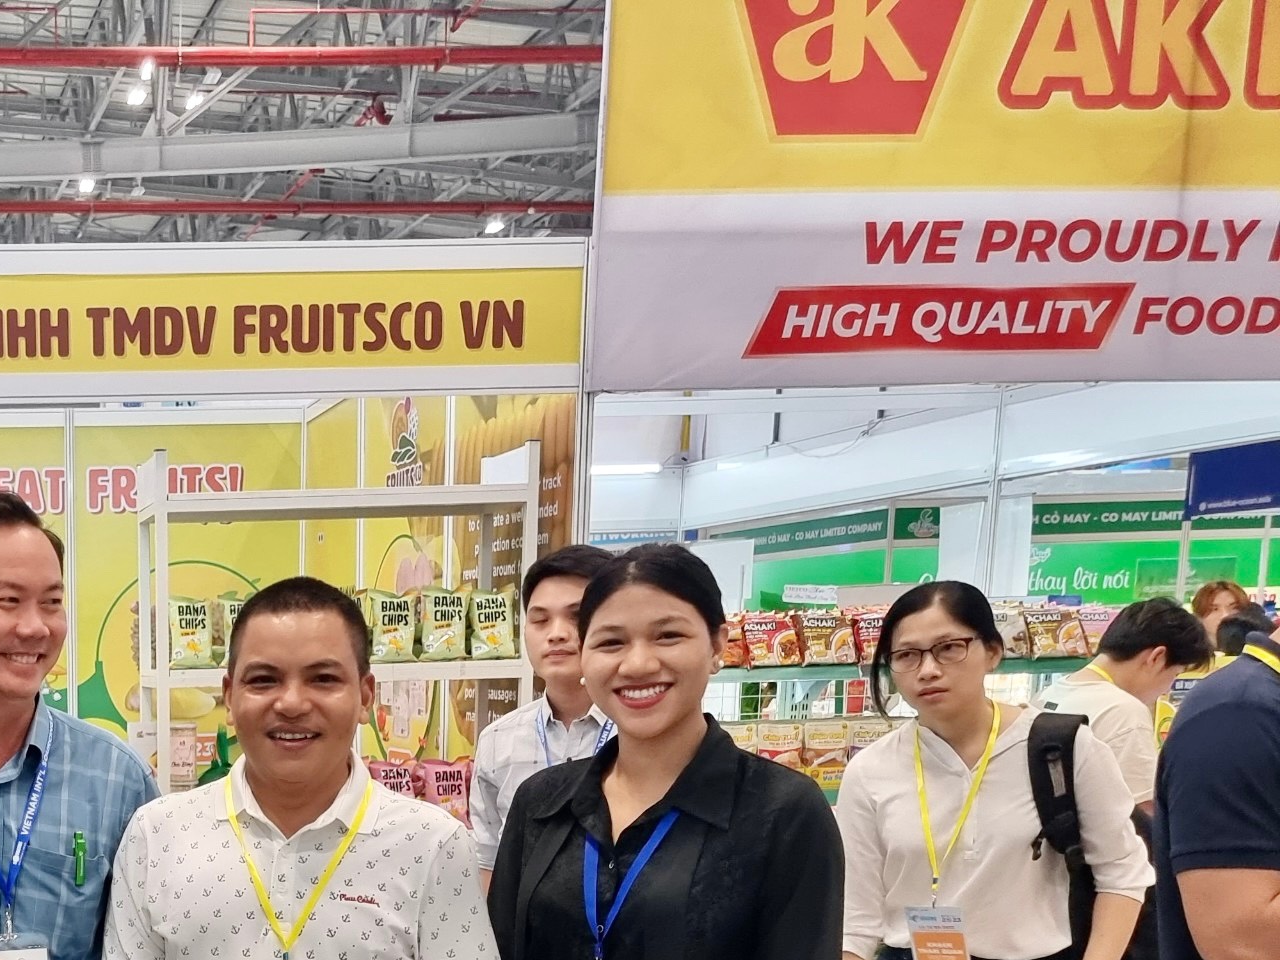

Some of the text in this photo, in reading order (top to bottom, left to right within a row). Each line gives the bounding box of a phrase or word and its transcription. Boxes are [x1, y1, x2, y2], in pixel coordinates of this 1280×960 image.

[864, 219, 1261, 264] WE PROUDLY
[781, 302, 900, 338] HIGH
[911, 299, 1112, 343] QUALITY
[86, 305, 217, 357] TMDV
[233, 301, 444, 354] FRUITSCO
[460, 299, 525, 349] VN
[1064, 513, 1091, 524] MAY
[1101, 513, 1119, 522] CO
[1122, 511, 1148, 522] MAY
[779, 531, 791, 542] MAY
[805, 528, 819, 540] MAY
[848, 522, 882, 535] COMPANY
[1103, 570, 1130, 590] nói
[381, 600, 410, 612] BANA
[476, 597, 506, 610] BANA
[177, 604, 206, 617] BANA
[478, 610, 507, 623] CHIPS
[1027, 612, 1061, 622] ACHAKI
[179, 618, 206, 630] CHIPS
[382, 613, 409, 626] CHIPS
[802, 618, 836, 628] ACHAKI
[744, 622, 776, 631] ACHAKI
[435, 771, 463, 782] BANA
[437, 784, 462, 796] CHIPS
[21, 790, 40, 836] VIETNAM
